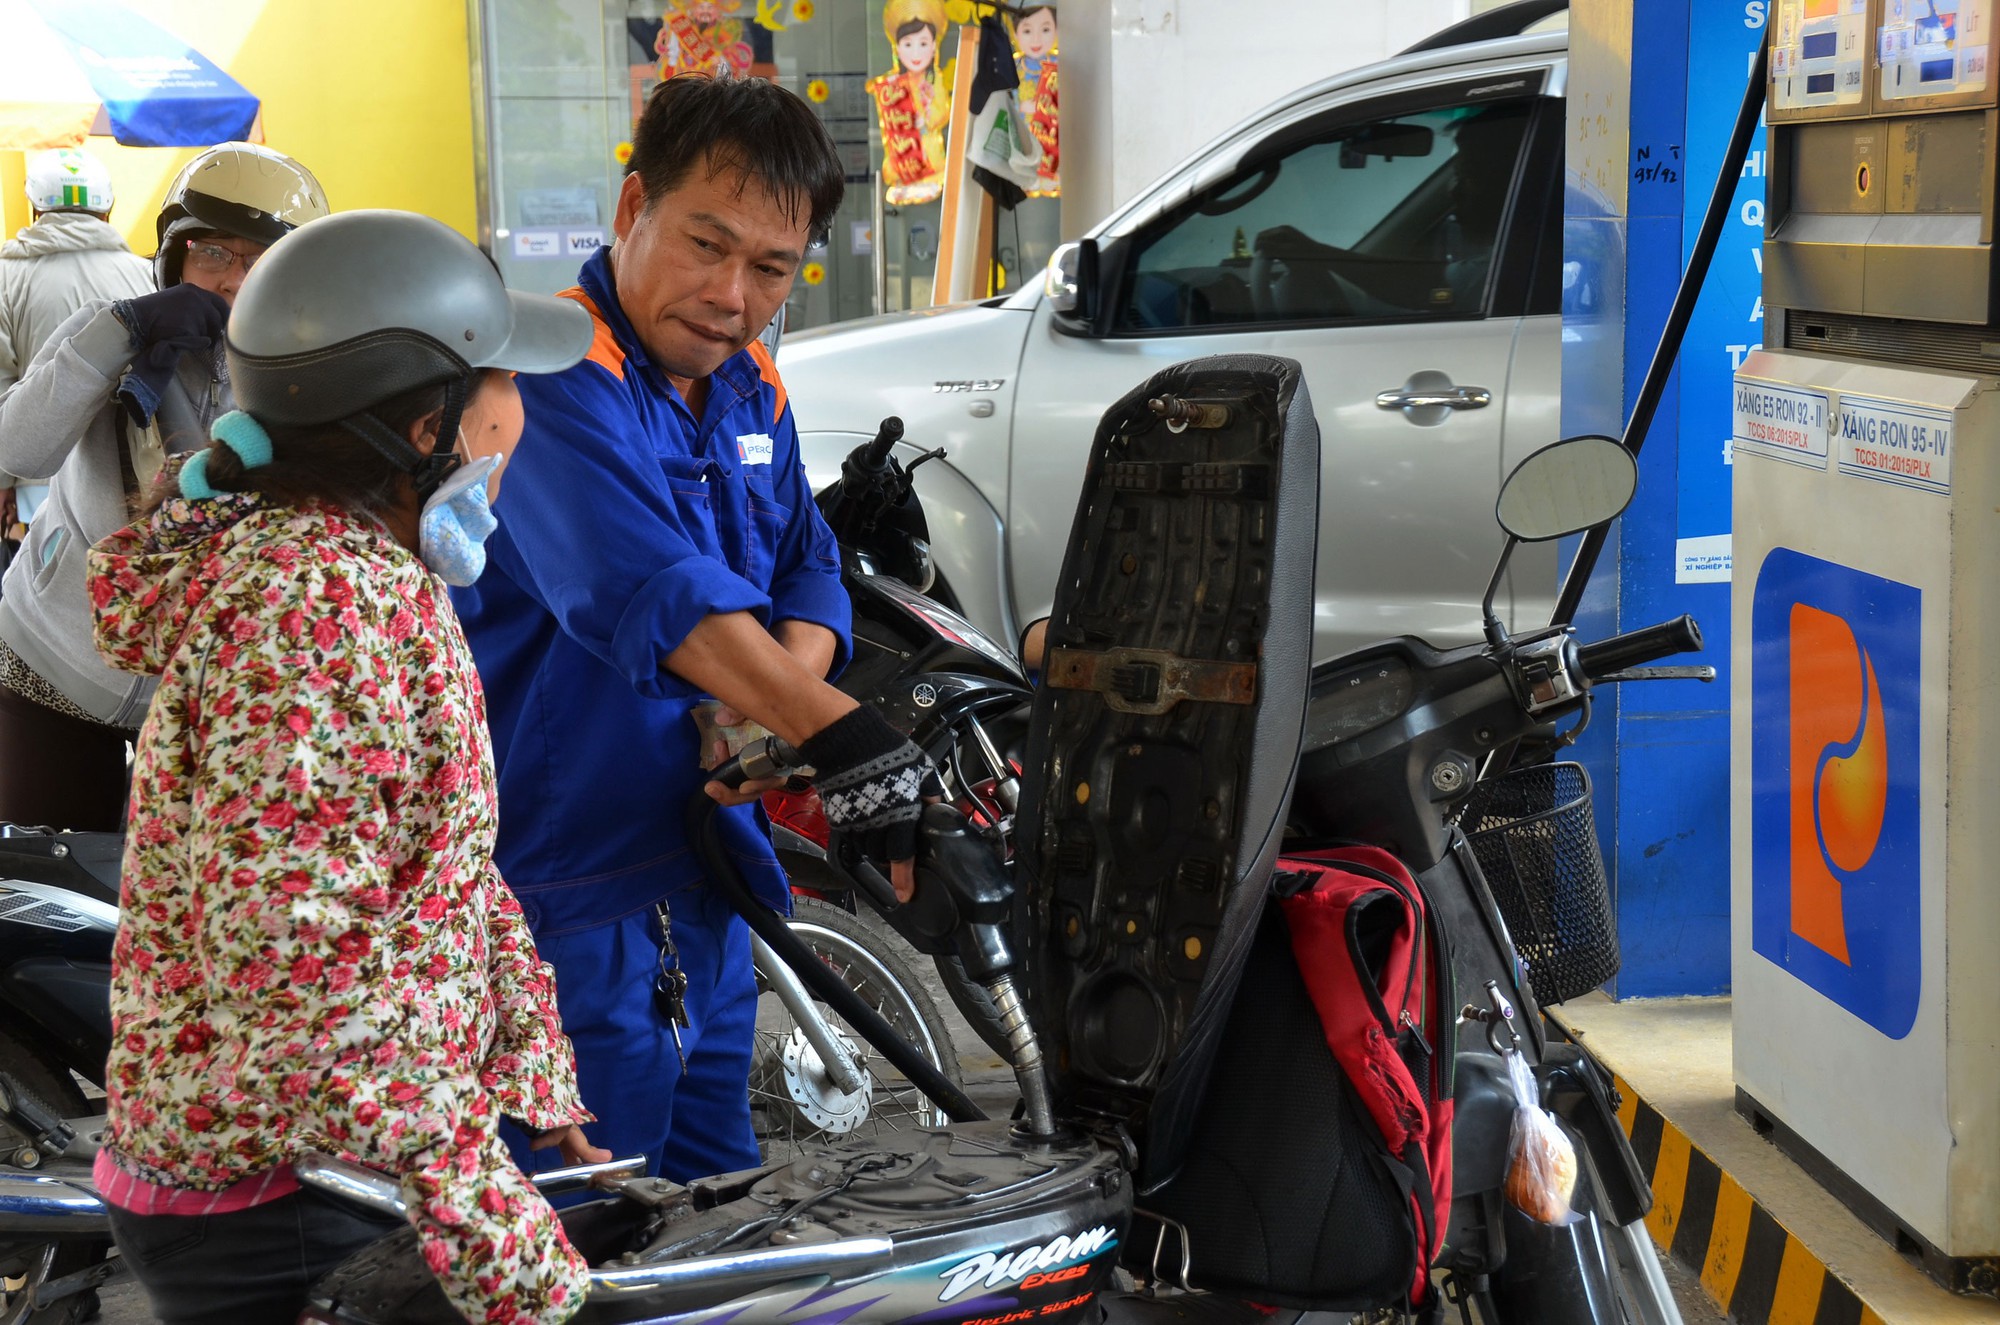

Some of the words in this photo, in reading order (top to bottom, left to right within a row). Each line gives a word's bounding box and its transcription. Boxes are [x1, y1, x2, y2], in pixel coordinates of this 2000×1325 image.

[1744, 1, 1771, 29] S
[1637, 145, 1650, 162] N
[1740, 151, 1766, 178] H
[1634, 161, 1678, 184] 95/92
[1741, 199, 1765, 228] Q
[569, 237, 601, 250] VISA
[1737, 387, 1761, 415] XĂNG
[1763, 395, 1774, 418] E5
[1776, 397, 1795, 423] RON
[1797, 402, 1808, 425] 92
[1747, 421, 1766, 439] TCCS
[1767, 425, 1808, 449] 06:2015/PLX
[1842, 409, 1876, 443] XĂNG
[1880, 420, 1907, 449] RON
[1855, 448, 1877, 467] TCCS
[1879, 453, 1931, 478] 01:2015/PLX
[938, 1225, 1116, 1302] Dream
[1019, 1264, 1091, 1290] Exces
[1040, 1292, 1093, 1315] Starter
